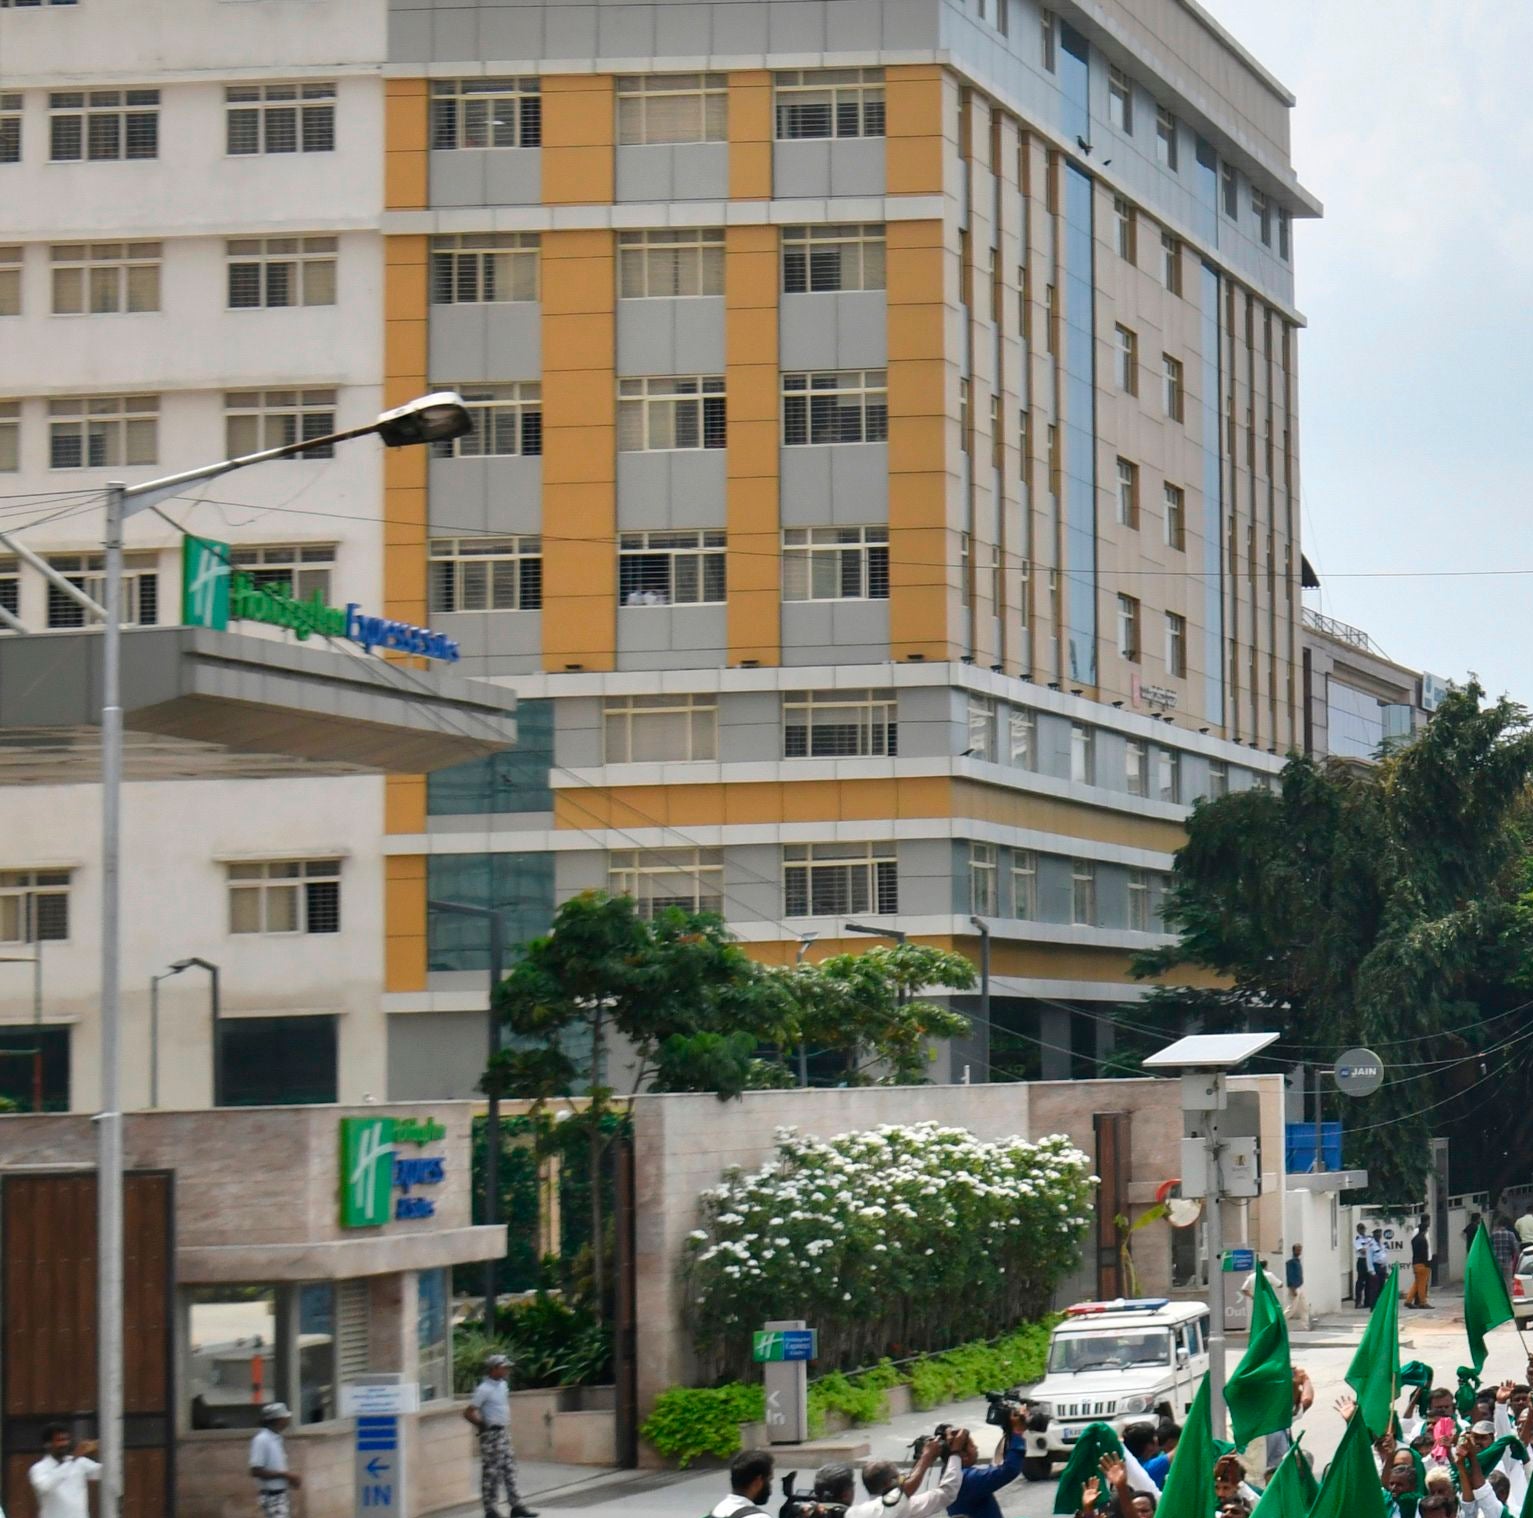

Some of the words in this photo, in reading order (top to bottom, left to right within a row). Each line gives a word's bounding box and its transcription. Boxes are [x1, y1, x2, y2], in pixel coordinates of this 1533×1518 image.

[1351, 1067, 1377, 1077] JAIN
[1384, 1241, 1403, 1250] AIN
[766, 1409, 785, 1425] In
[362, 1485, 392, 1506] IN
